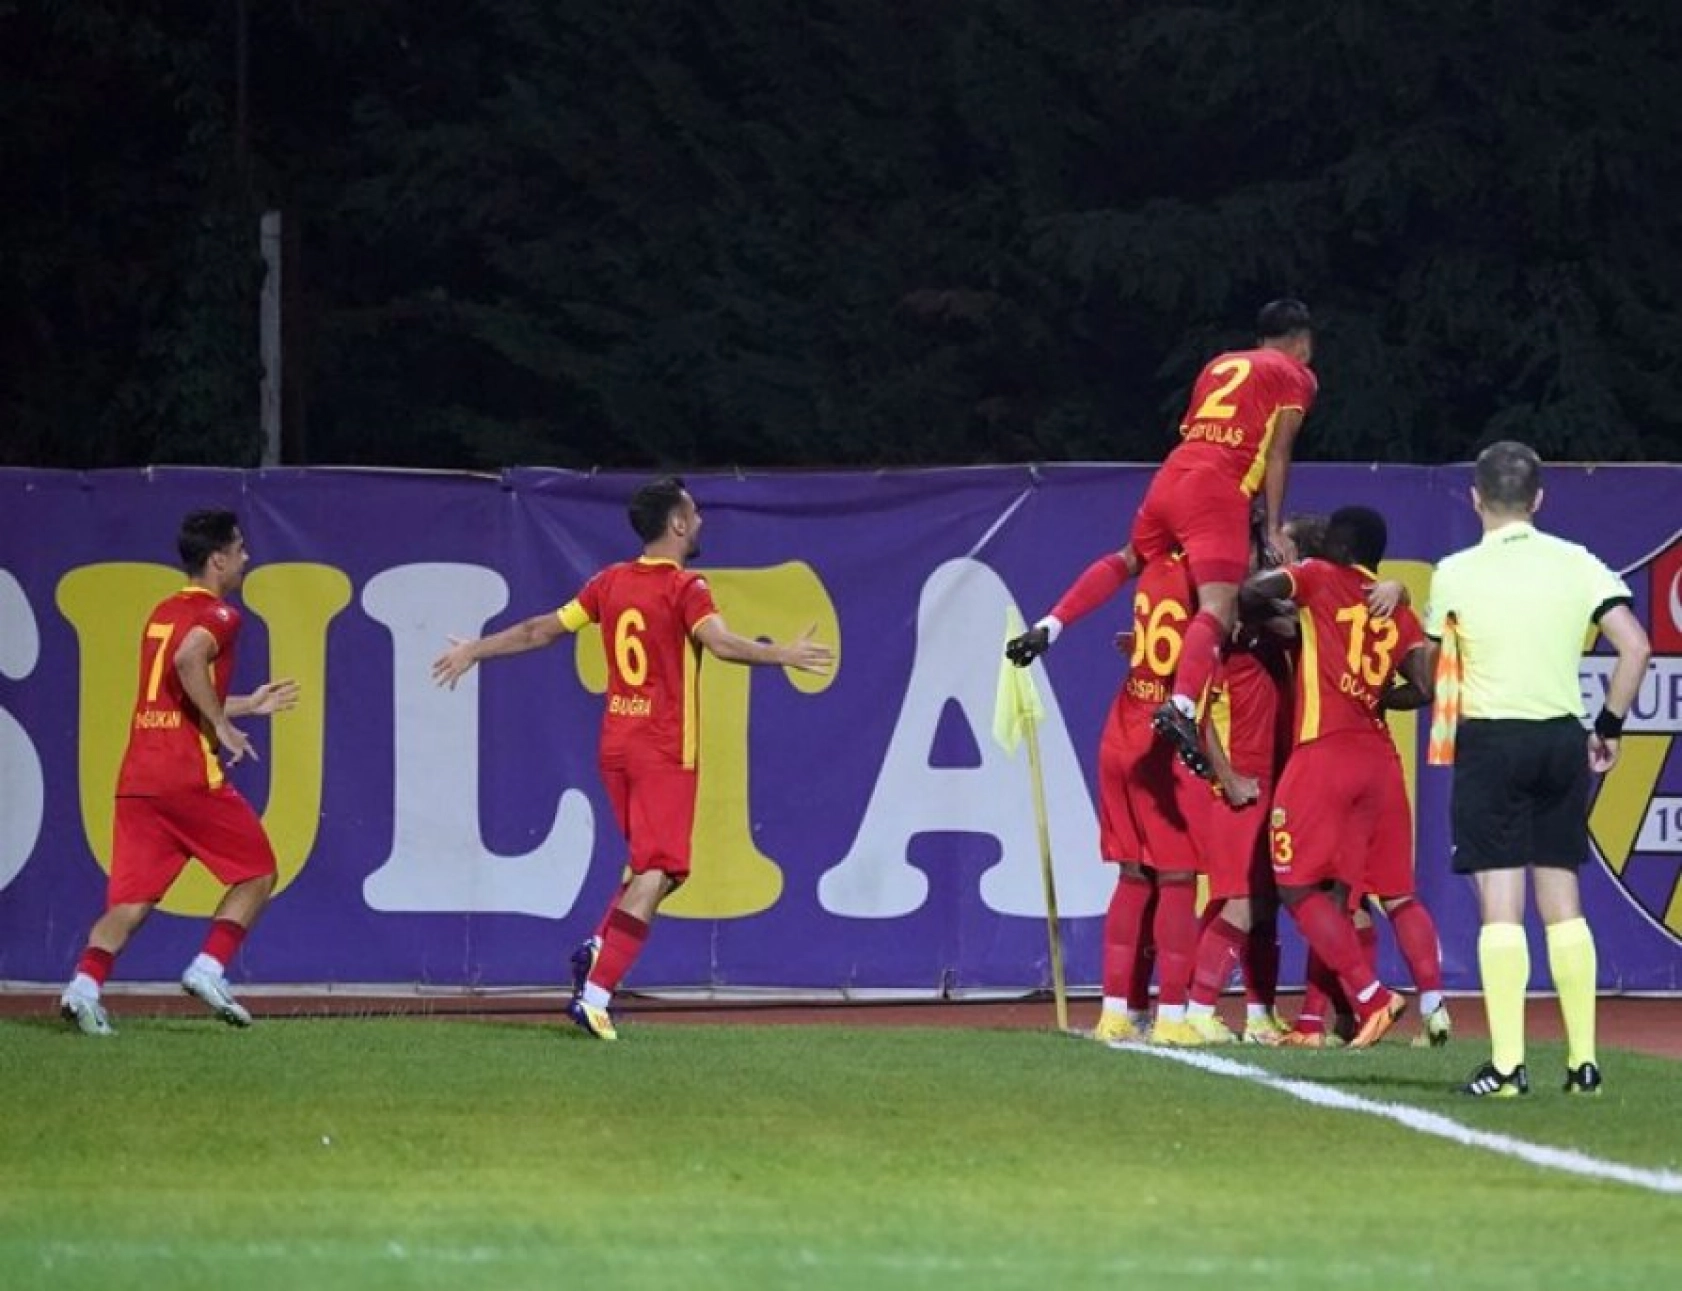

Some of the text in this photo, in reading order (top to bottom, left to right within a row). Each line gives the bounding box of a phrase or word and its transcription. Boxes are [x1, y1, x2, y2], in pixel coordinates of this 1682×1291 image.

[1195, 358, 1251, 419] 2
[146, 623, 174, 702] 7
[615, 607, 648, 686] 6
[1335, 603, 1398, 686] 13
[0, 559, 1436, 918] ULTA
